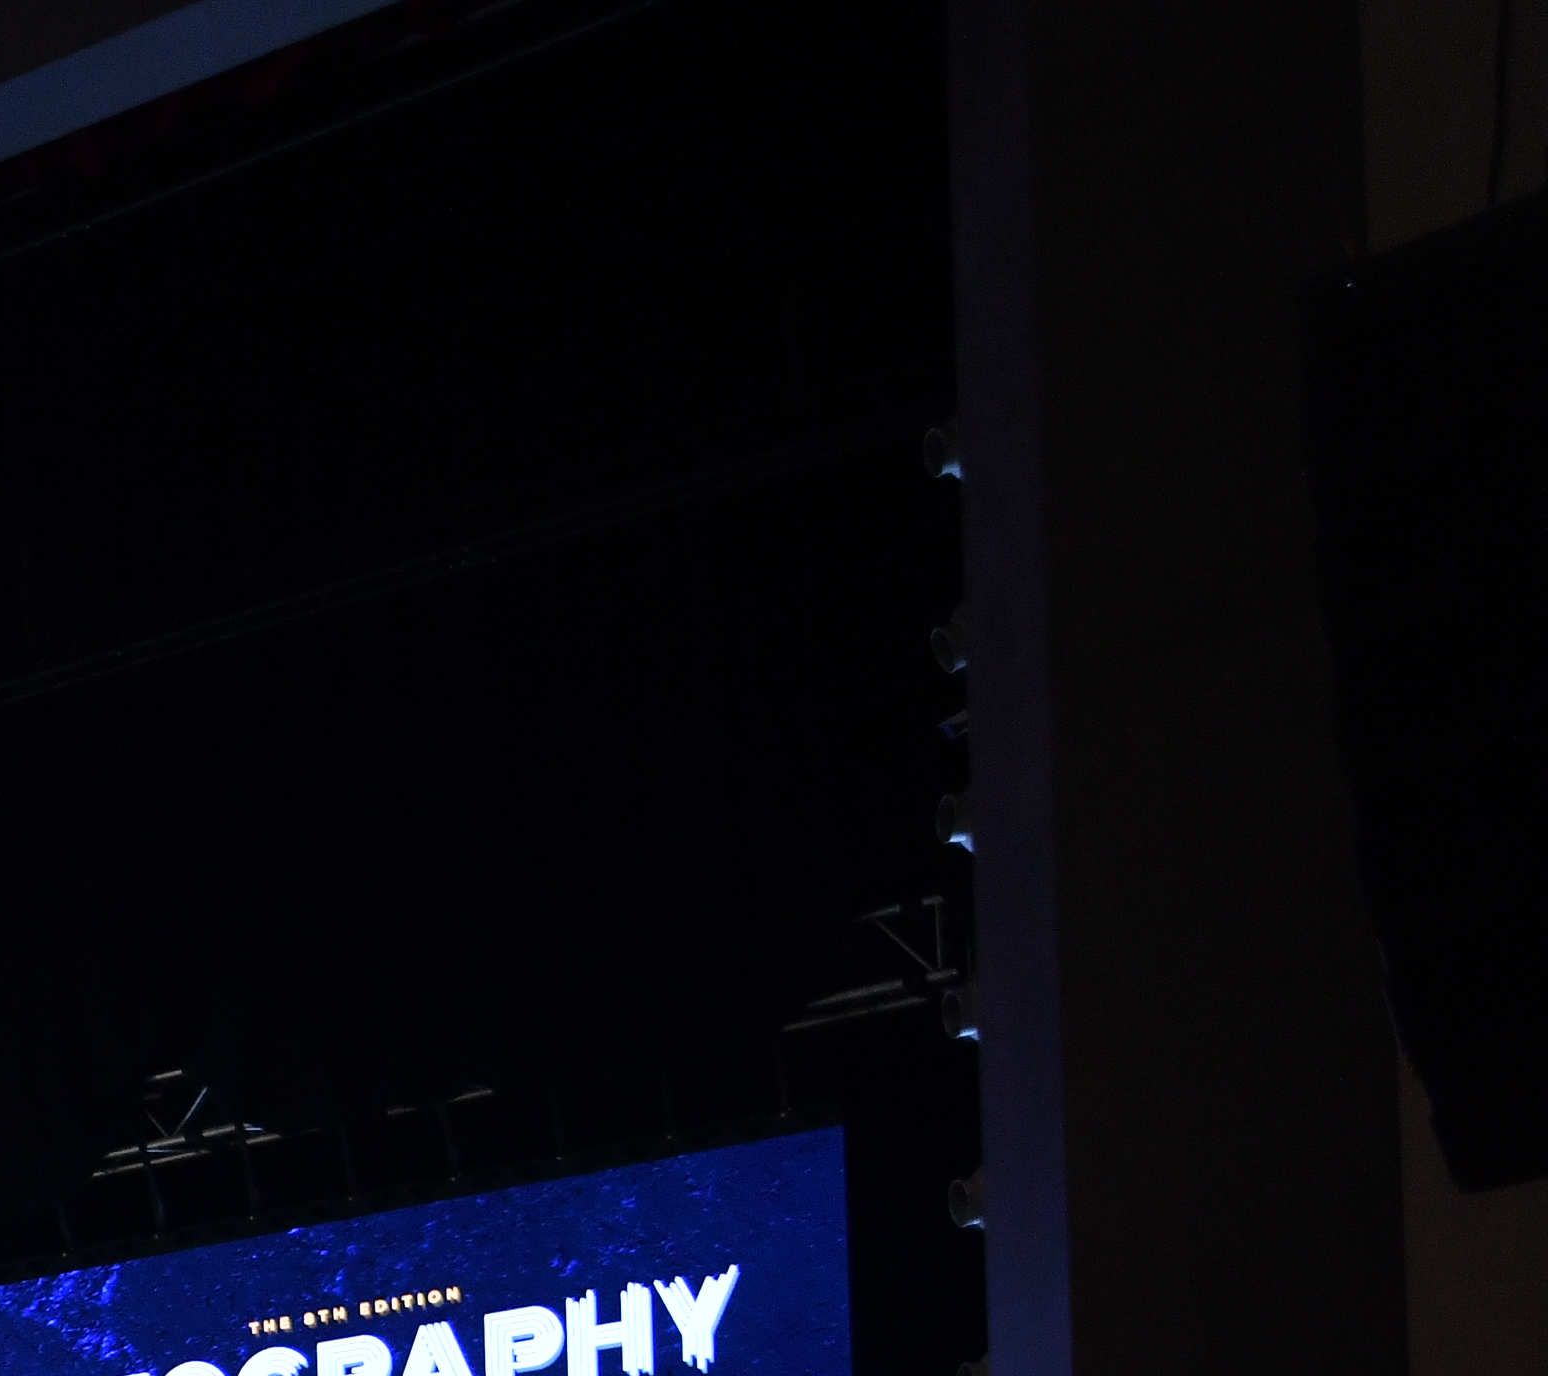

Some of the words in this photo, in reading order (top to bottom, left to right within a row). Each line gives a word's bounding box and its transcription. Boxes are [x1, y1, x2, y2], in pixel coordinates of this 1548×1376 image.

[249, 1317, 290, 1336] THE
[303, 1307, 346, 1327] 8TH
[359, 1286, 462, 1319] EDITION
